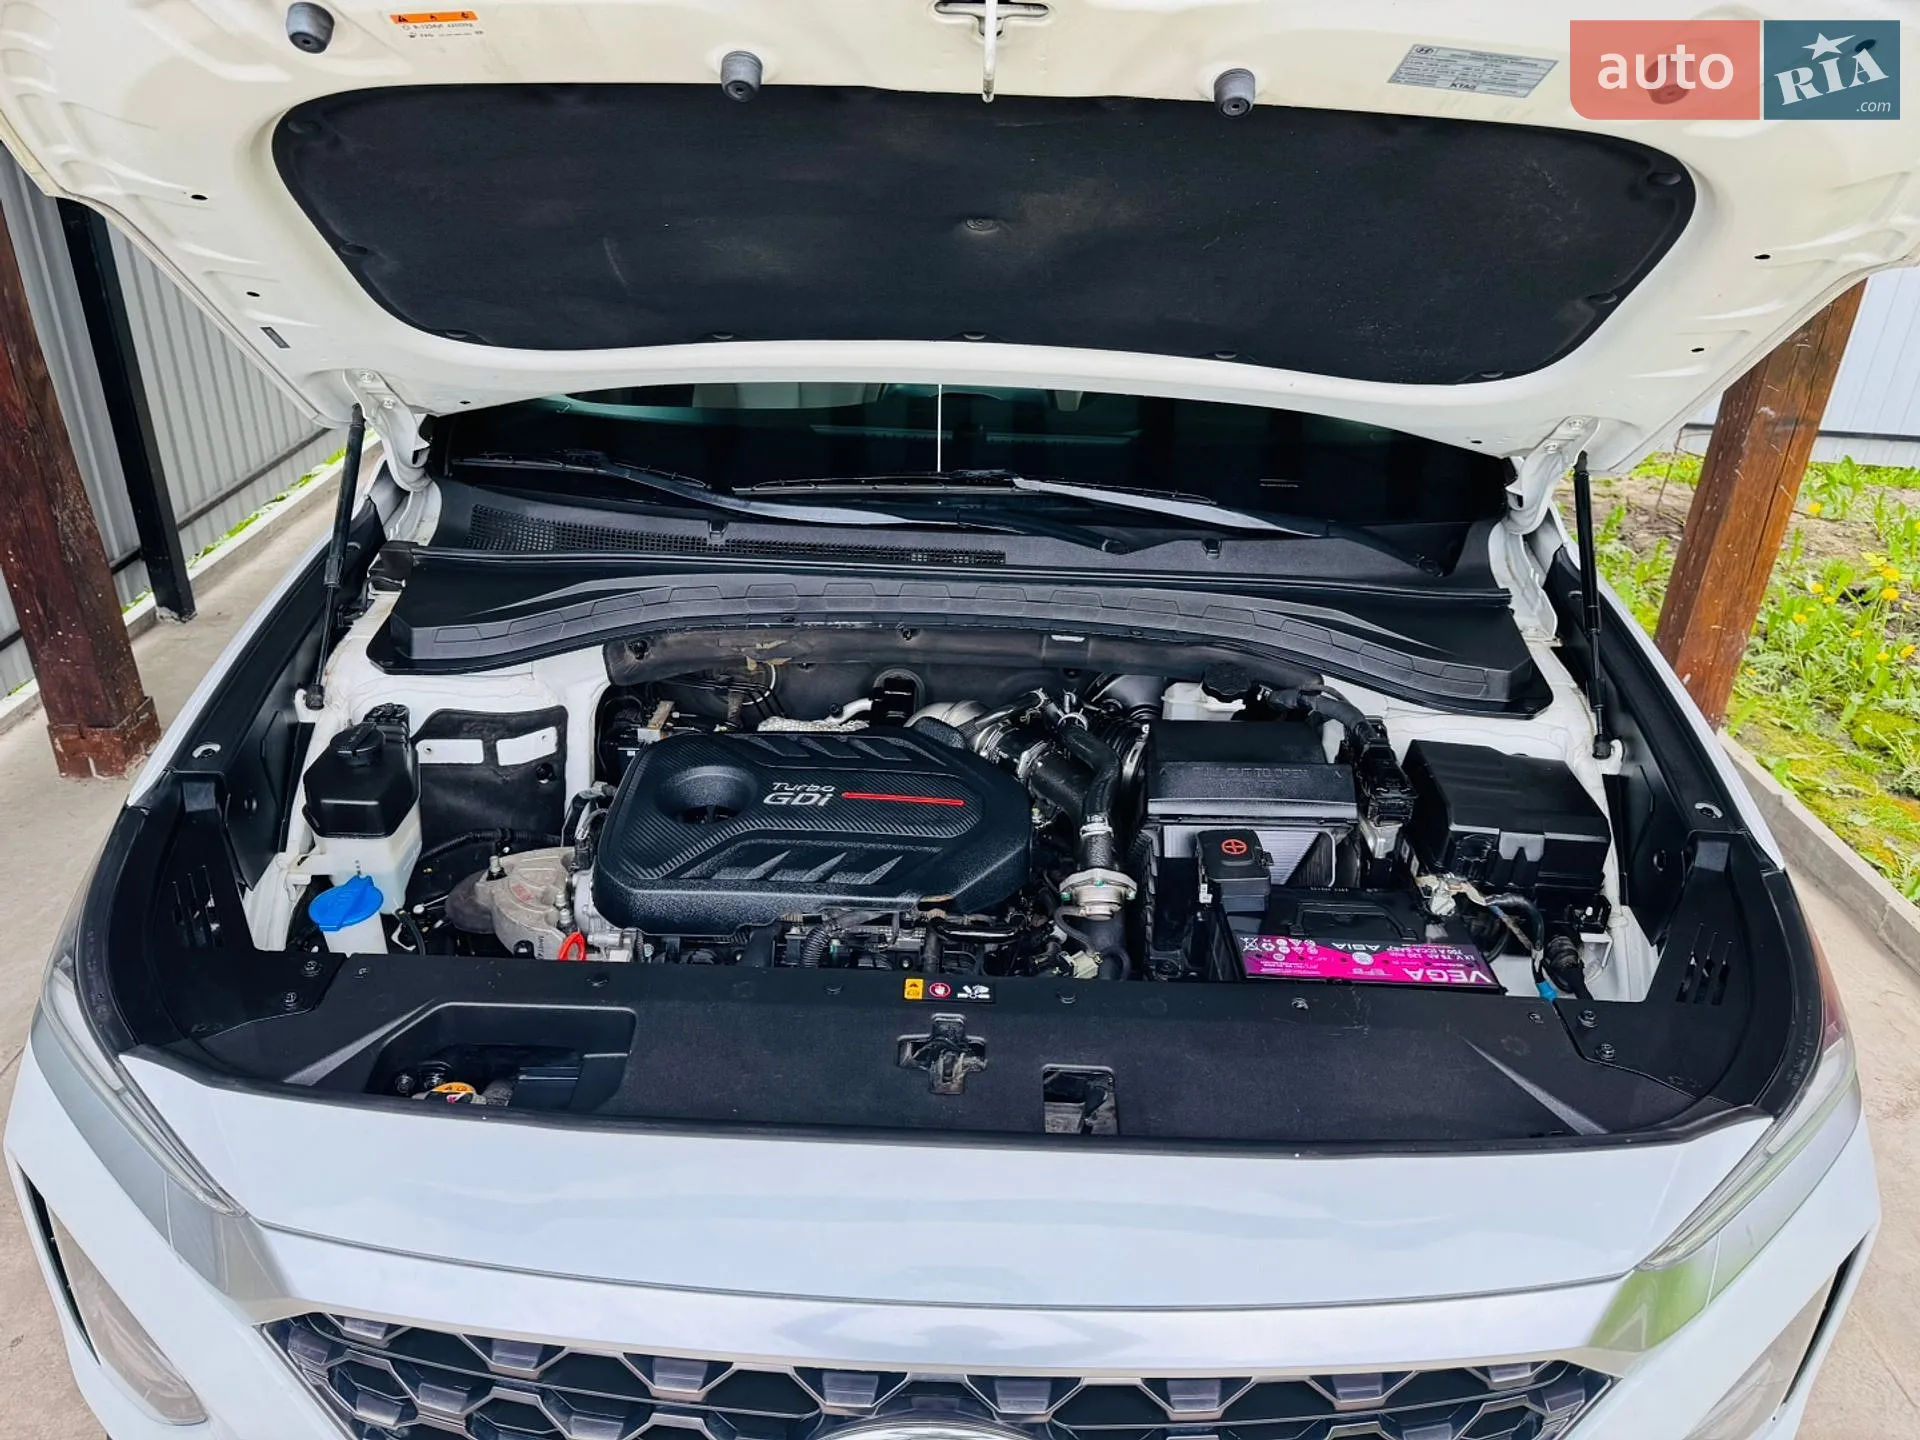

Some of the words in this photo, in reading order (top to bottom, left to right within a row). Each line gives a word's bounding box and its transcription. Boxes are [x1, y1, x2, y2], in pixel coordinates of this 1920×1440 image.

[772, 782, 835, 792] Turbo
[763, 791, 834, 807] GDi
[1332, 941, 1381, 952] ASIA
[1402, 967, 1493, 984] VEGA
